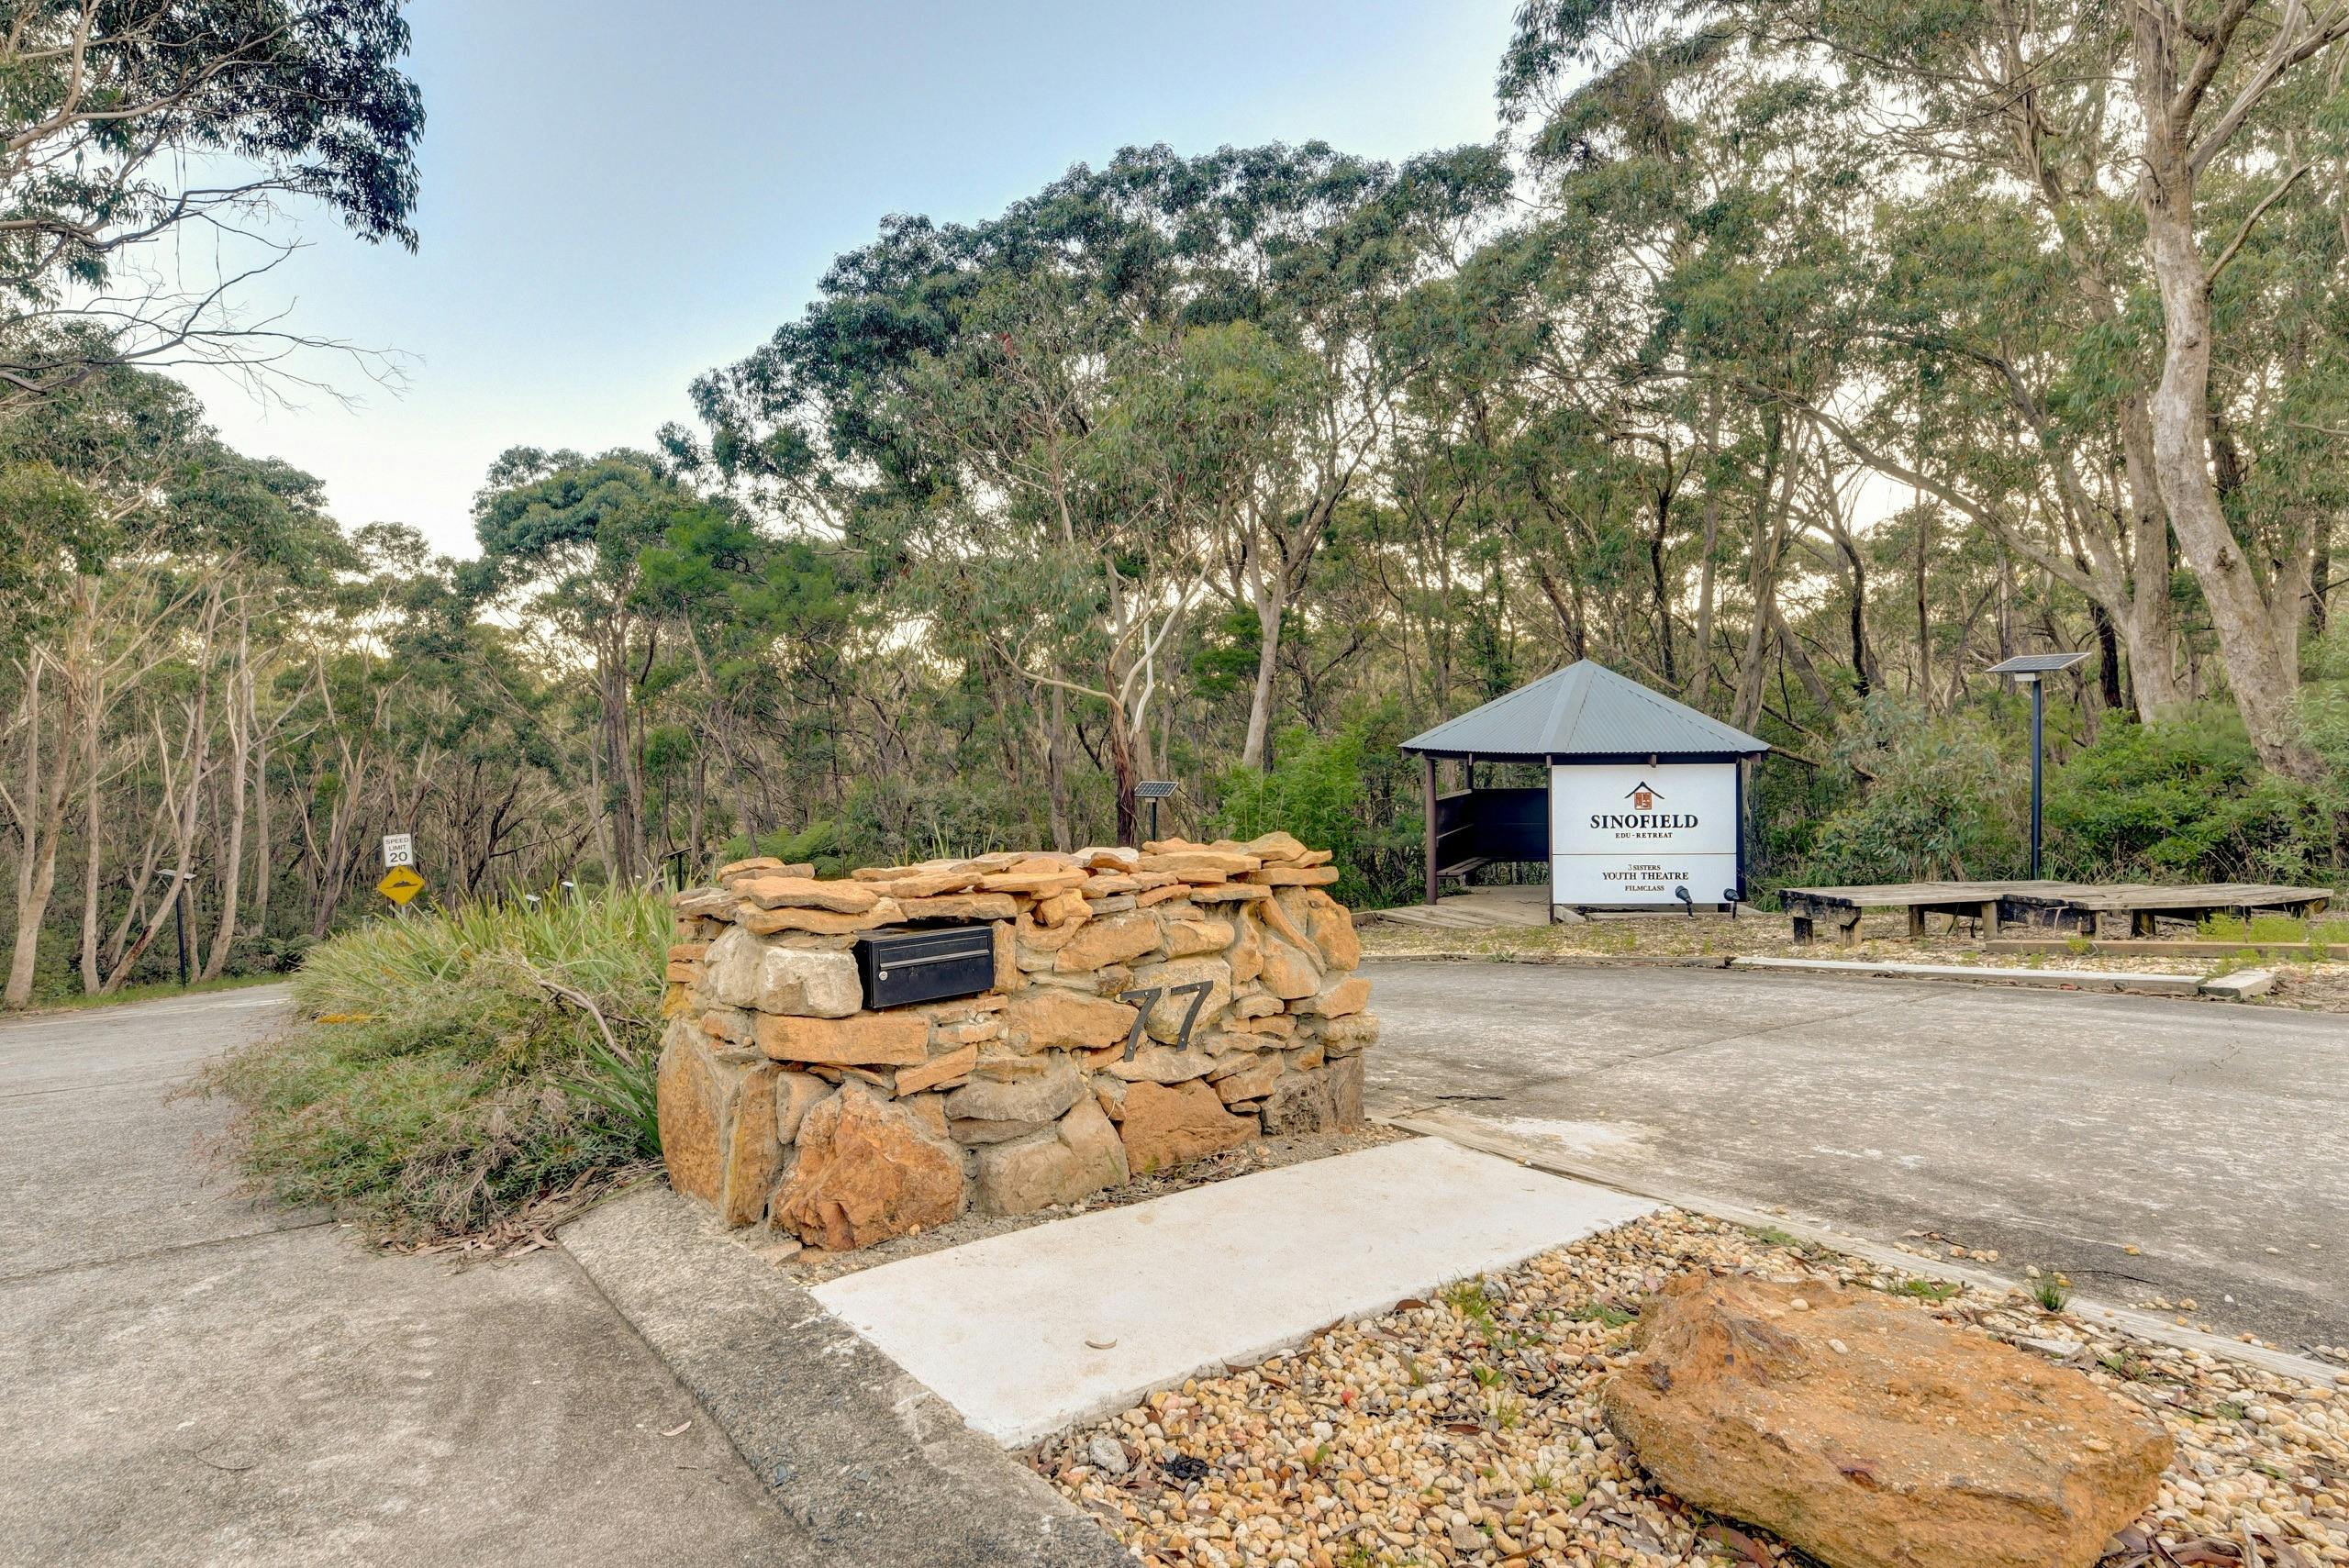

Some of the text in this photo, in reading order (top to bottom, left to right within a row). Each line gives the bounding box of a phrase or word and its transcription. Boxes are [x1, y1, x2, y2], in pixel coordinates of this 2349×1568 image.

[1590, 814, 1698, 828] SINOFIELD
[389, 851, 407, 862] 20
[1602, 872, 1689, 880] YOUTH THEATRE
[1119, 980, 1214, 1062] 77
